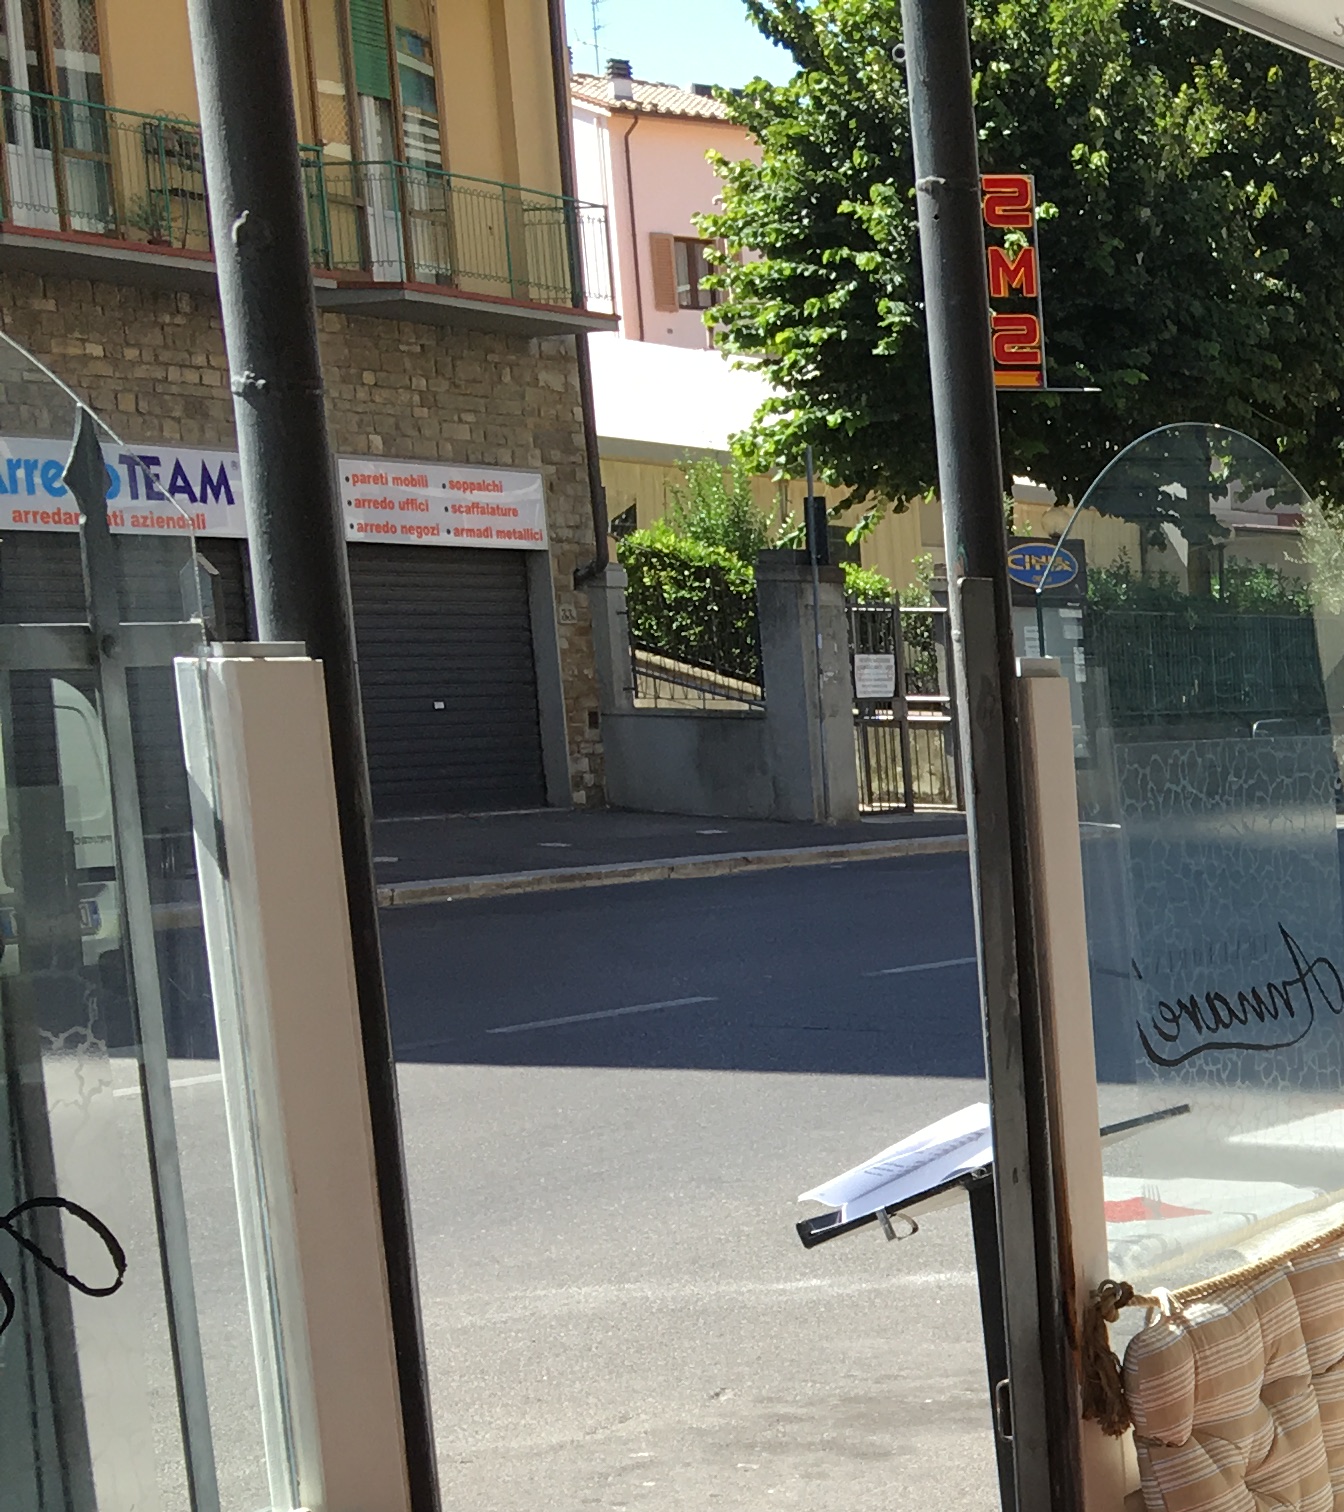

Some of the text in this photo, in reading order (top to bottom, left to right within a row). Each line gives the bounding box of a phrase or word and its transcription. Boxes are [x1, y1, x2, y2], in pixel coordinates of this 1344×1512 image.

[352, 473, 429, 489] pareti mobili
[448, 479, 503, 494] soppalchi
[354, 497, 429, 513] arredo uffici
[450, 502, 519, 518] scaffalature
[356, 521, 440, 539] arredo negozi
[453, 526, 543, 542] armadi metallici
